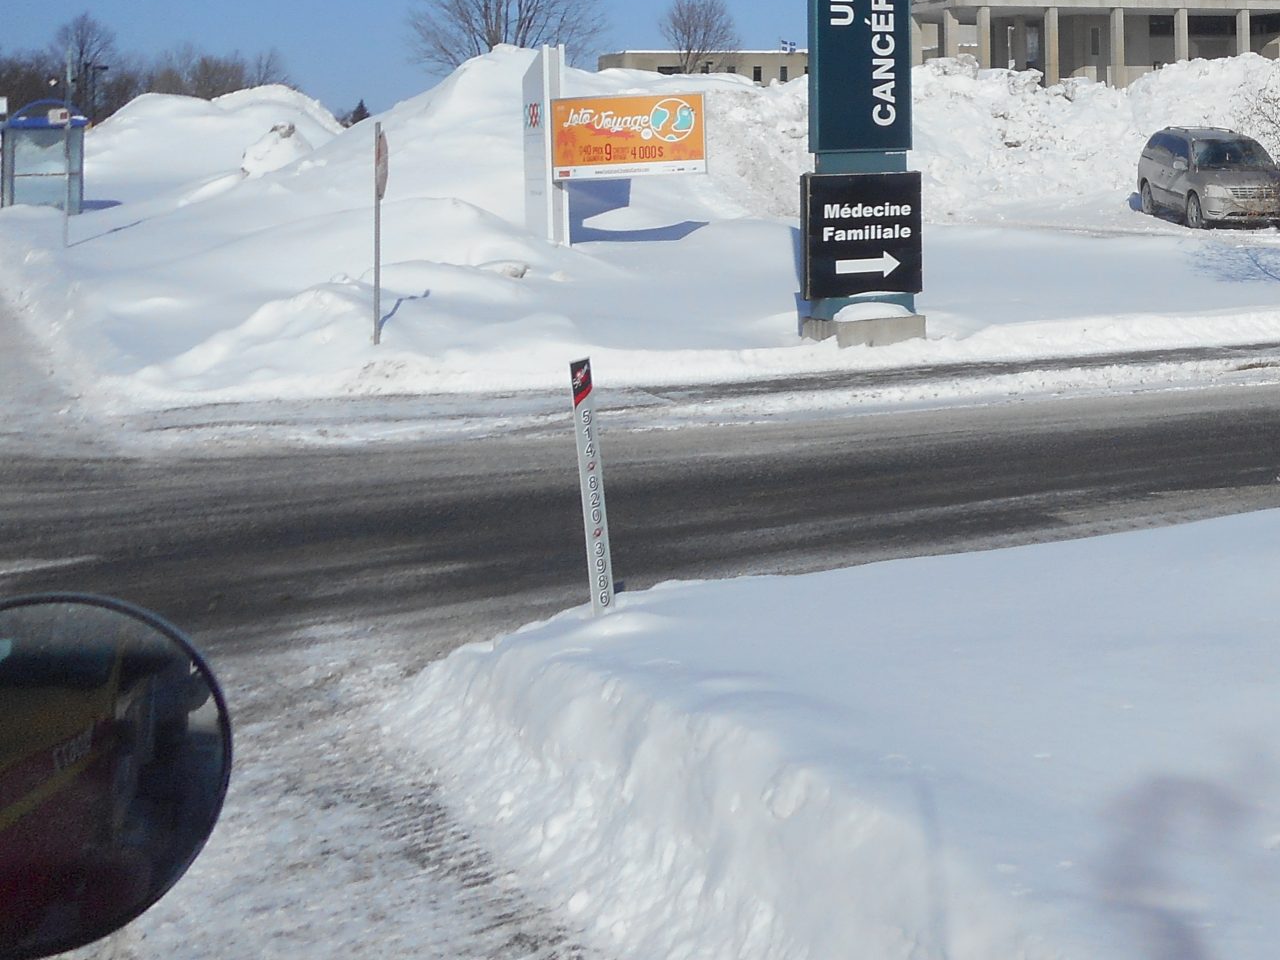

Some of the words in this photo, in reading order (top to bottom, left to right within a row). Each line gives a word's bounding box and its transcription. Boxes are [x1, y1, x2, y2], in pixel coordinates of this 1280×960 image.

[563, 108, 594, 128] Loto
[592, 111, 650, 132] Voyage
[604, 143, 613, 161] 9
[823, 202, 912, 219] Médecine
[822, 224, 912, 242] Familiale
